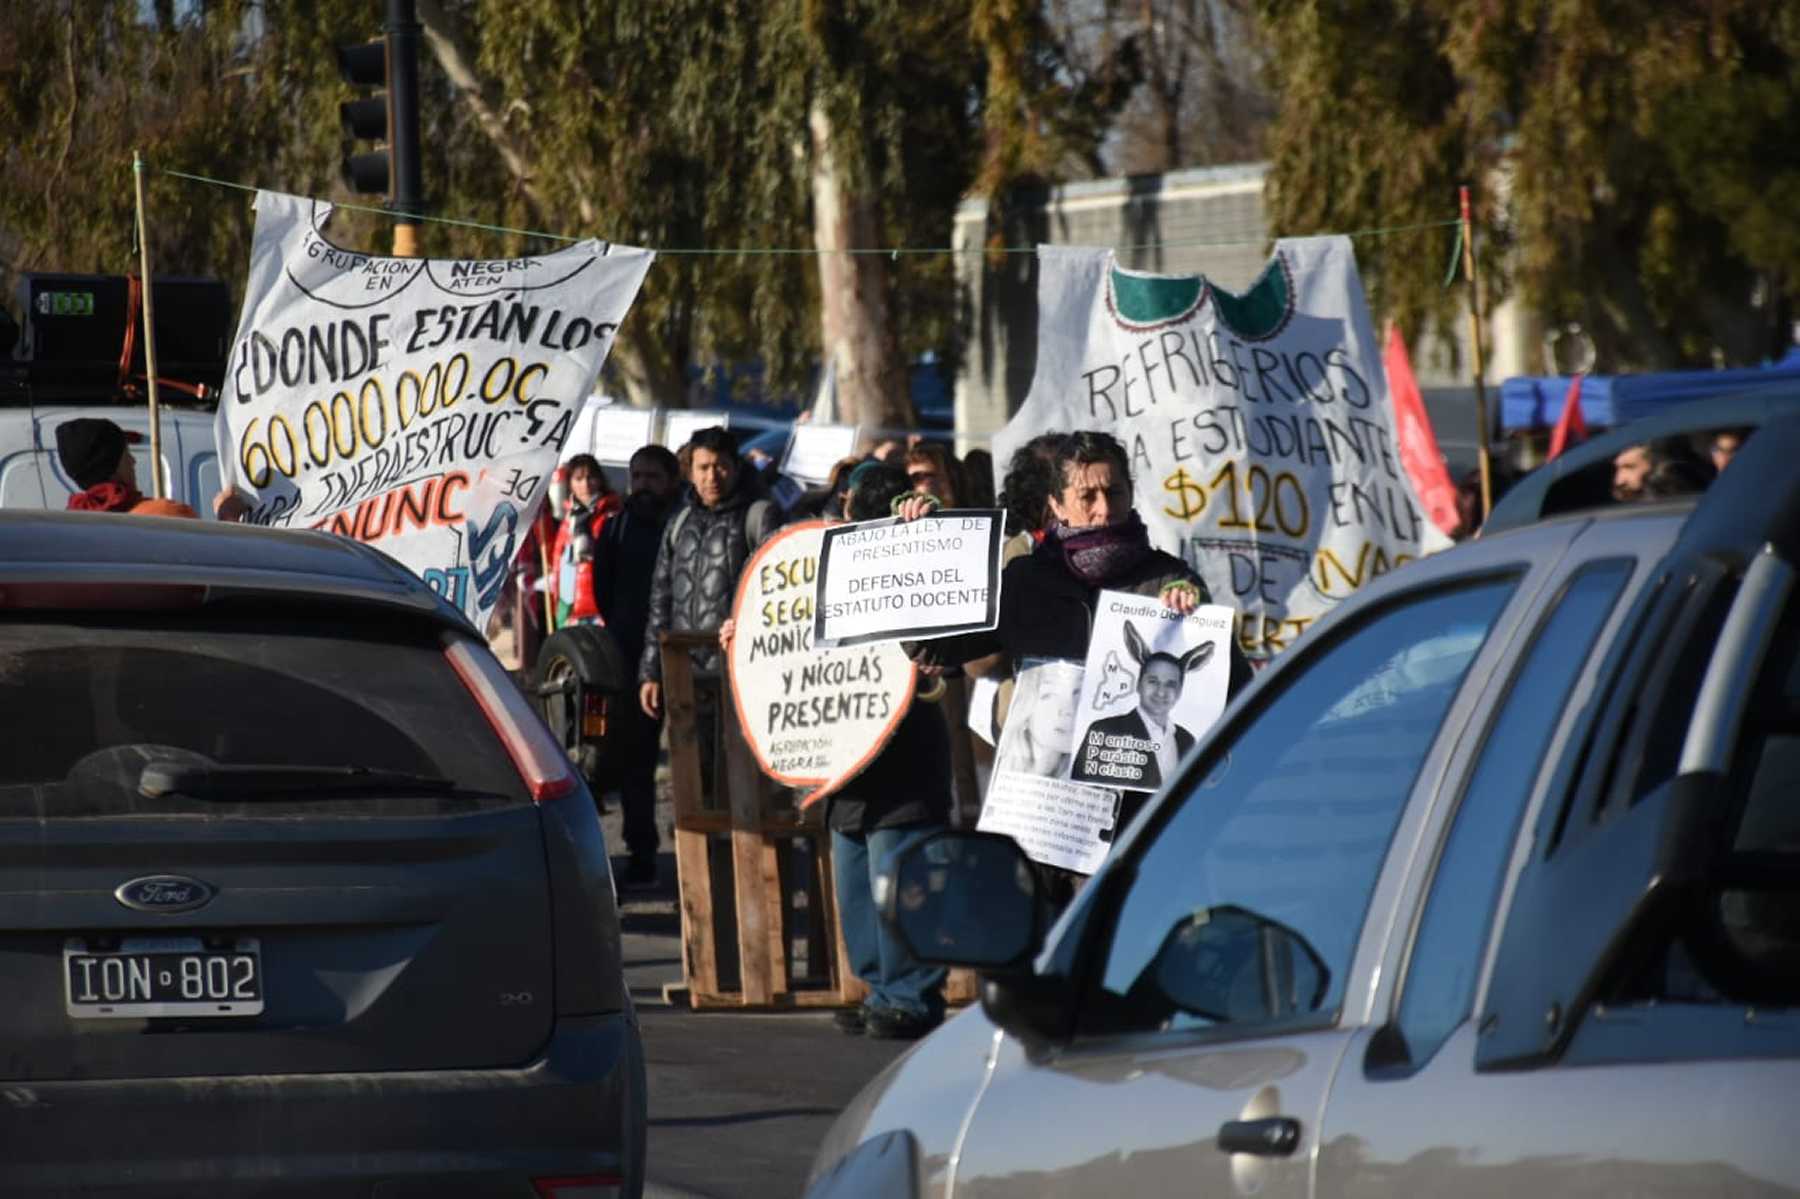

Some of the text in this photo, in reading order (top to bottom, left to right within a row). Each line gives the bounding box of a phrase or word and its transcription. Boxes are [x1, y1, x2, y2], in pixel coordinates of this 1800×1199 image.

[450, 259, 543, 277] NEGRA
[366, 275, 503, 290] EN ATEN
[1082, 329, 1371, 421] REFRIGERIOS
[1163, 458, 1310, 537] $120
[836, 529, 887, 548] ABAJO
[890, 524, 911, 539] LA
[960, 518, 987, 532] DE
[852, 537, 964, 563] PRESENTISMO
[848, 568, 964, 594] DEFENSA DEL
[1229, 551, 1281, 604] DE
[823, 587, 990, 619] ESTATUTO DOCENTE
[1109, 601, 1158, 618] Claudio
[1107, 663, 1118, 673] M
[1102, 690, 1111, 700] N
[1119, 682, 1128, 691] P
[768, 692, 890, 734] PRESENTES
[139, 882, 192, 903] Ford
[78, 957, 151, 1001] ION
[181, 956, 254, 998] 802
